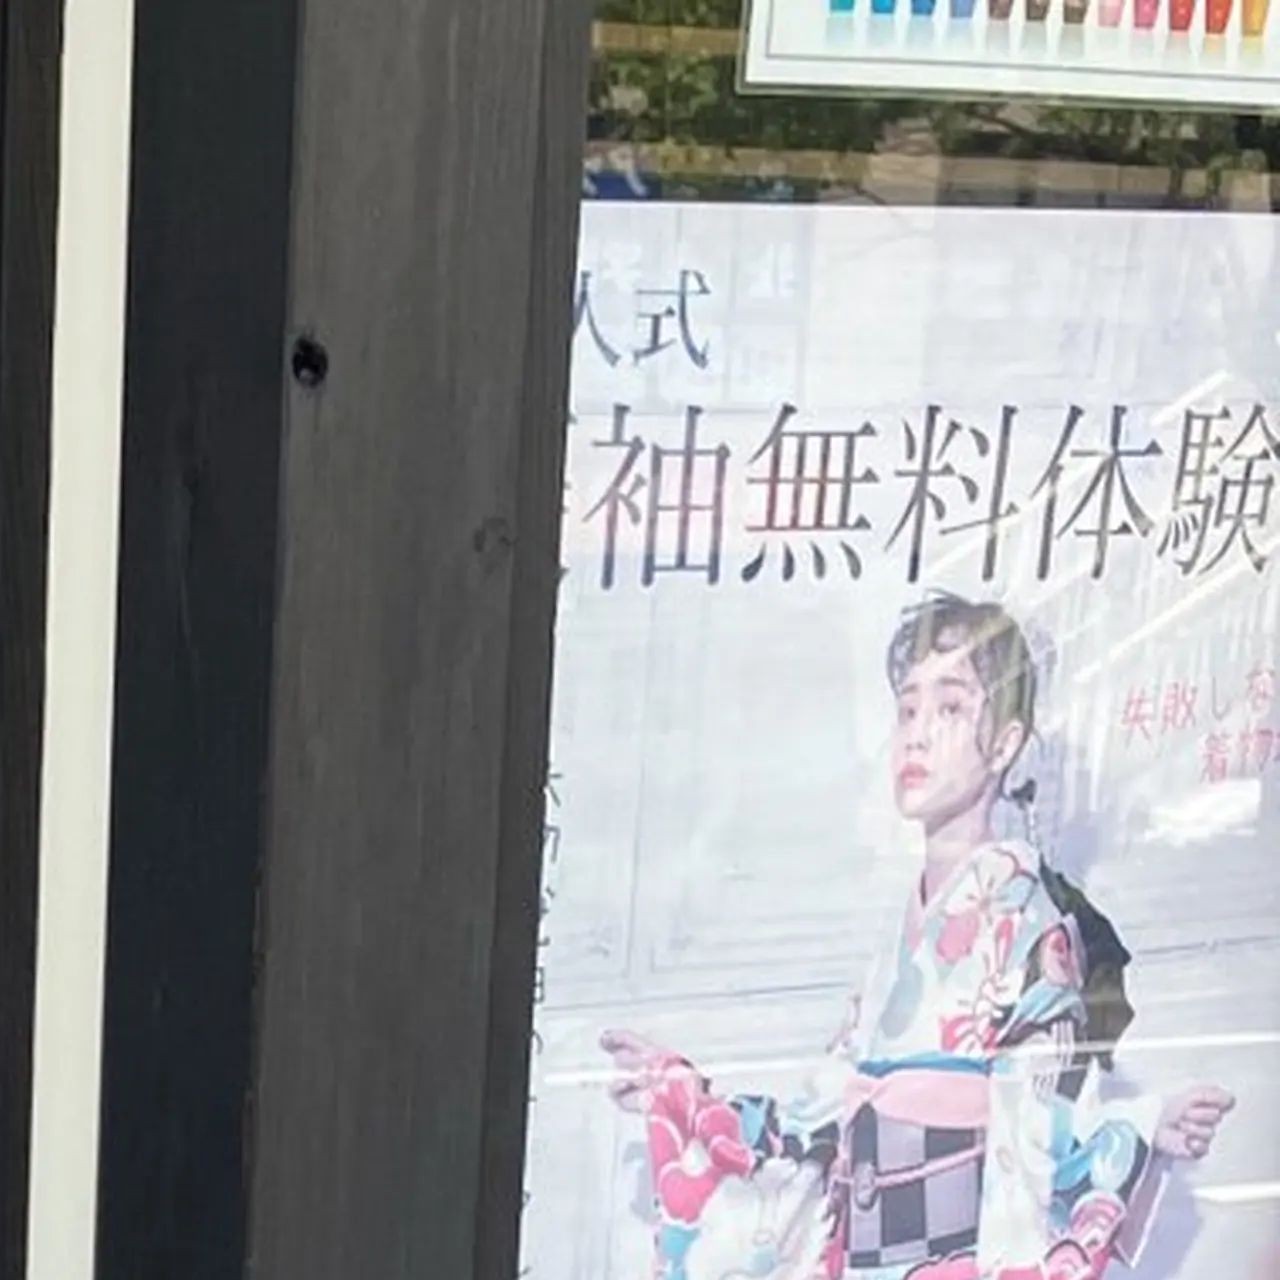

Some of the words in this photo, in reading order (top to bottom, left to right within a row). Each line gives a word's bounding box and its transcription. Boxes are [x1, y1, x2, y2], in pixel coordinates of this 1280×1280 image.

[582, 403, 1280, 590] 袖無料体験
